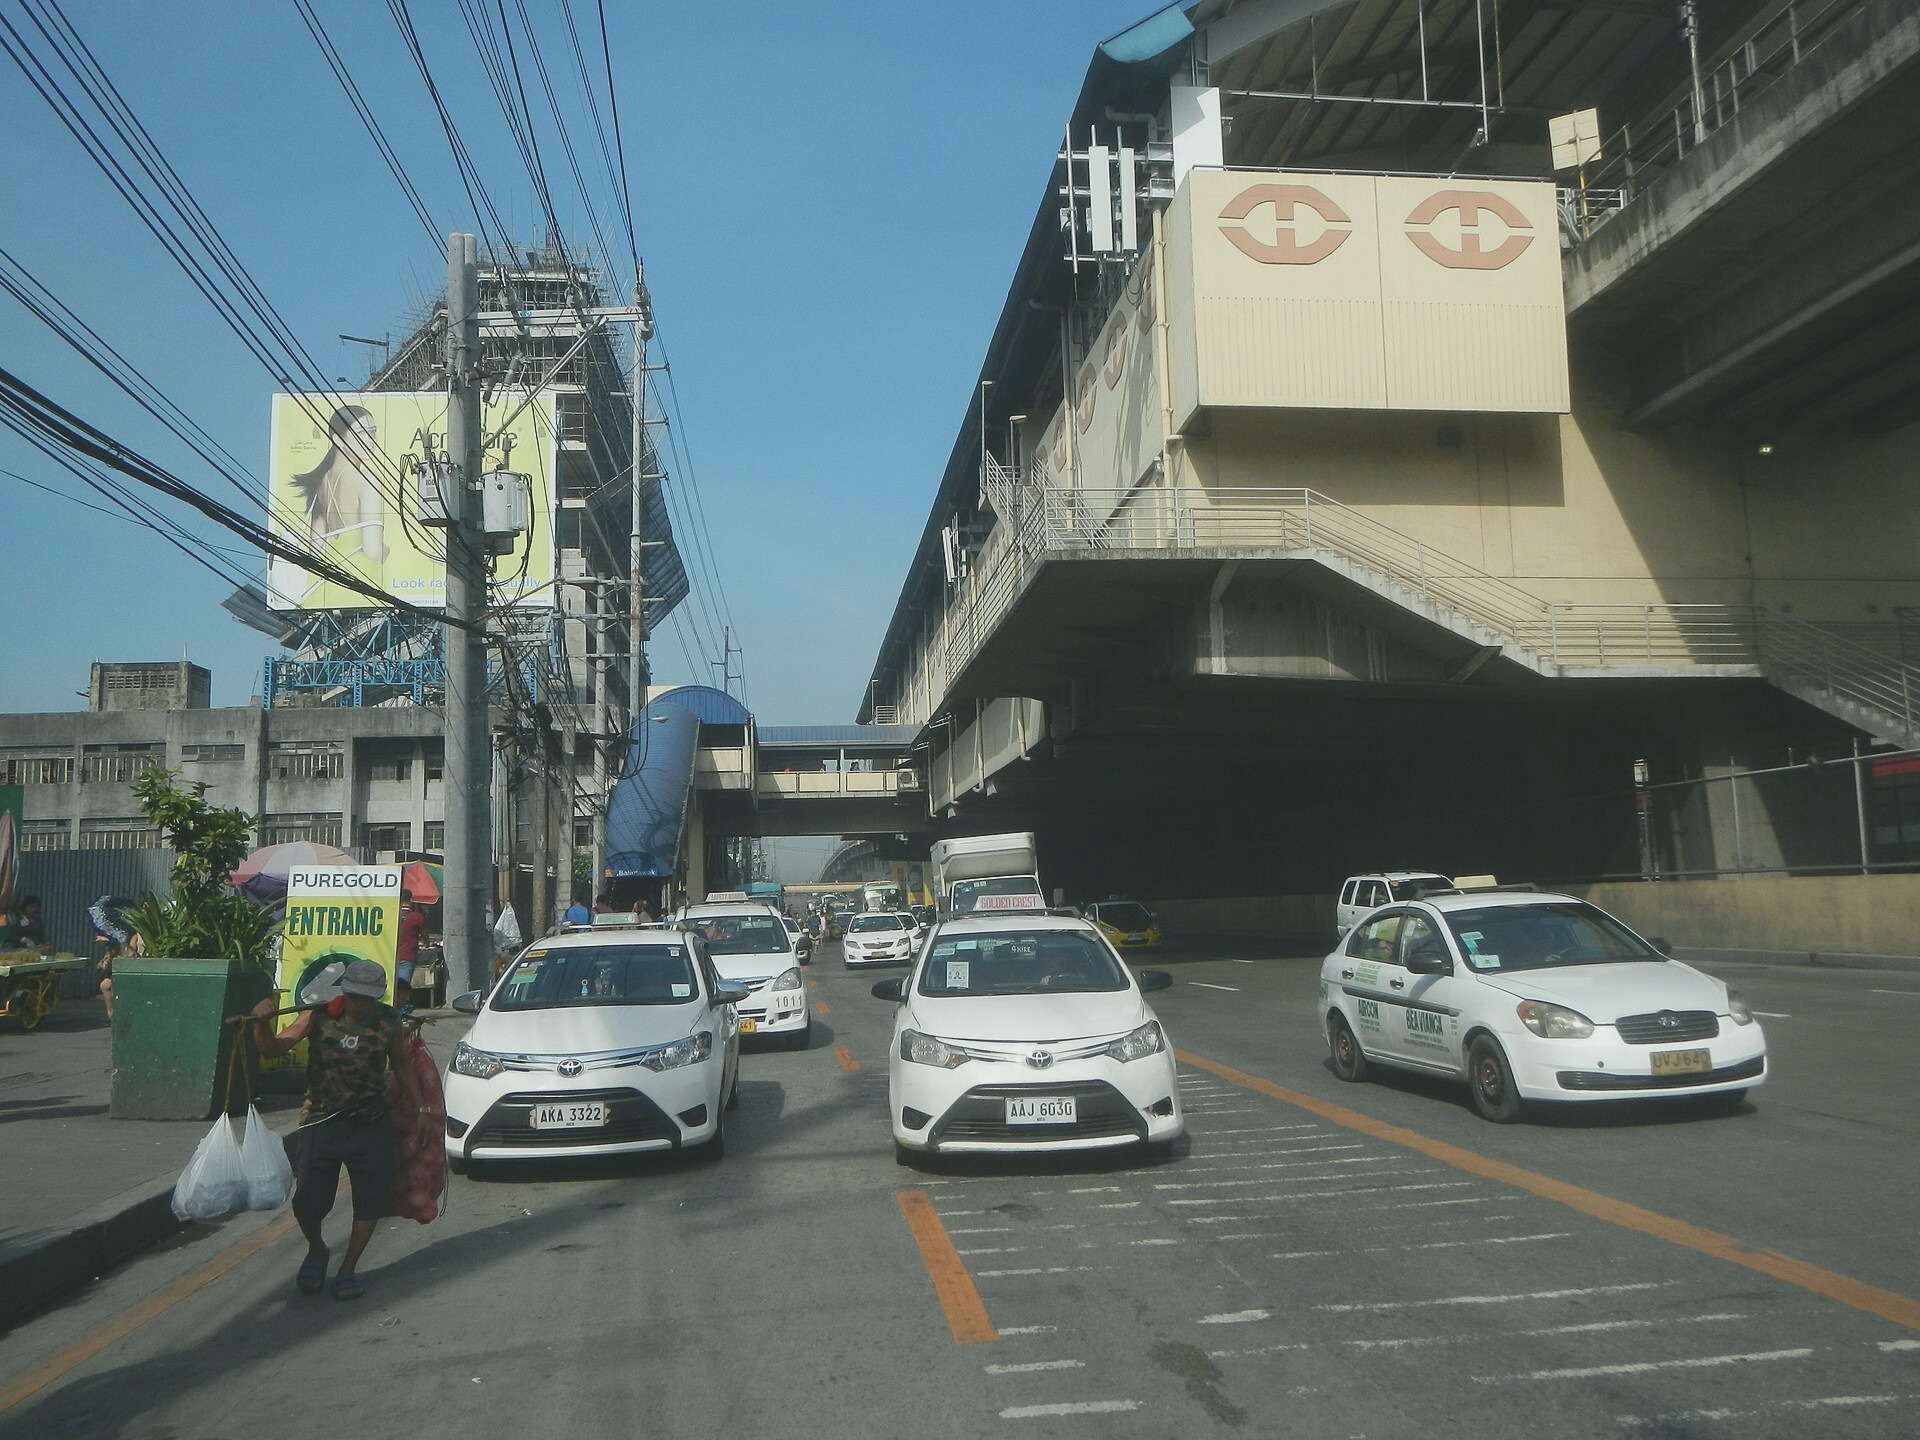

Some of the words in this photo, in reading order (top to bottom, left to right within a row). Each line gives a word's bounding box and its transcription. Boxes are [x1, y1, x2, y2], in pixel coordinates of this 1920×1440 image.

[392, 577, 425, 589] Look
[292, 873, 398, 888] PUREGOLD
[289, 906, 383, 936] ENTRANC
[775, 995, 803, 1008] 1011
[540, 1108, 564, 1122] AKA
[569, 1107, 601, 1121] 3322
[1011, 1102, 1034, 1117] AAJ
[1040, 1101, 1072, 1116] 6030
